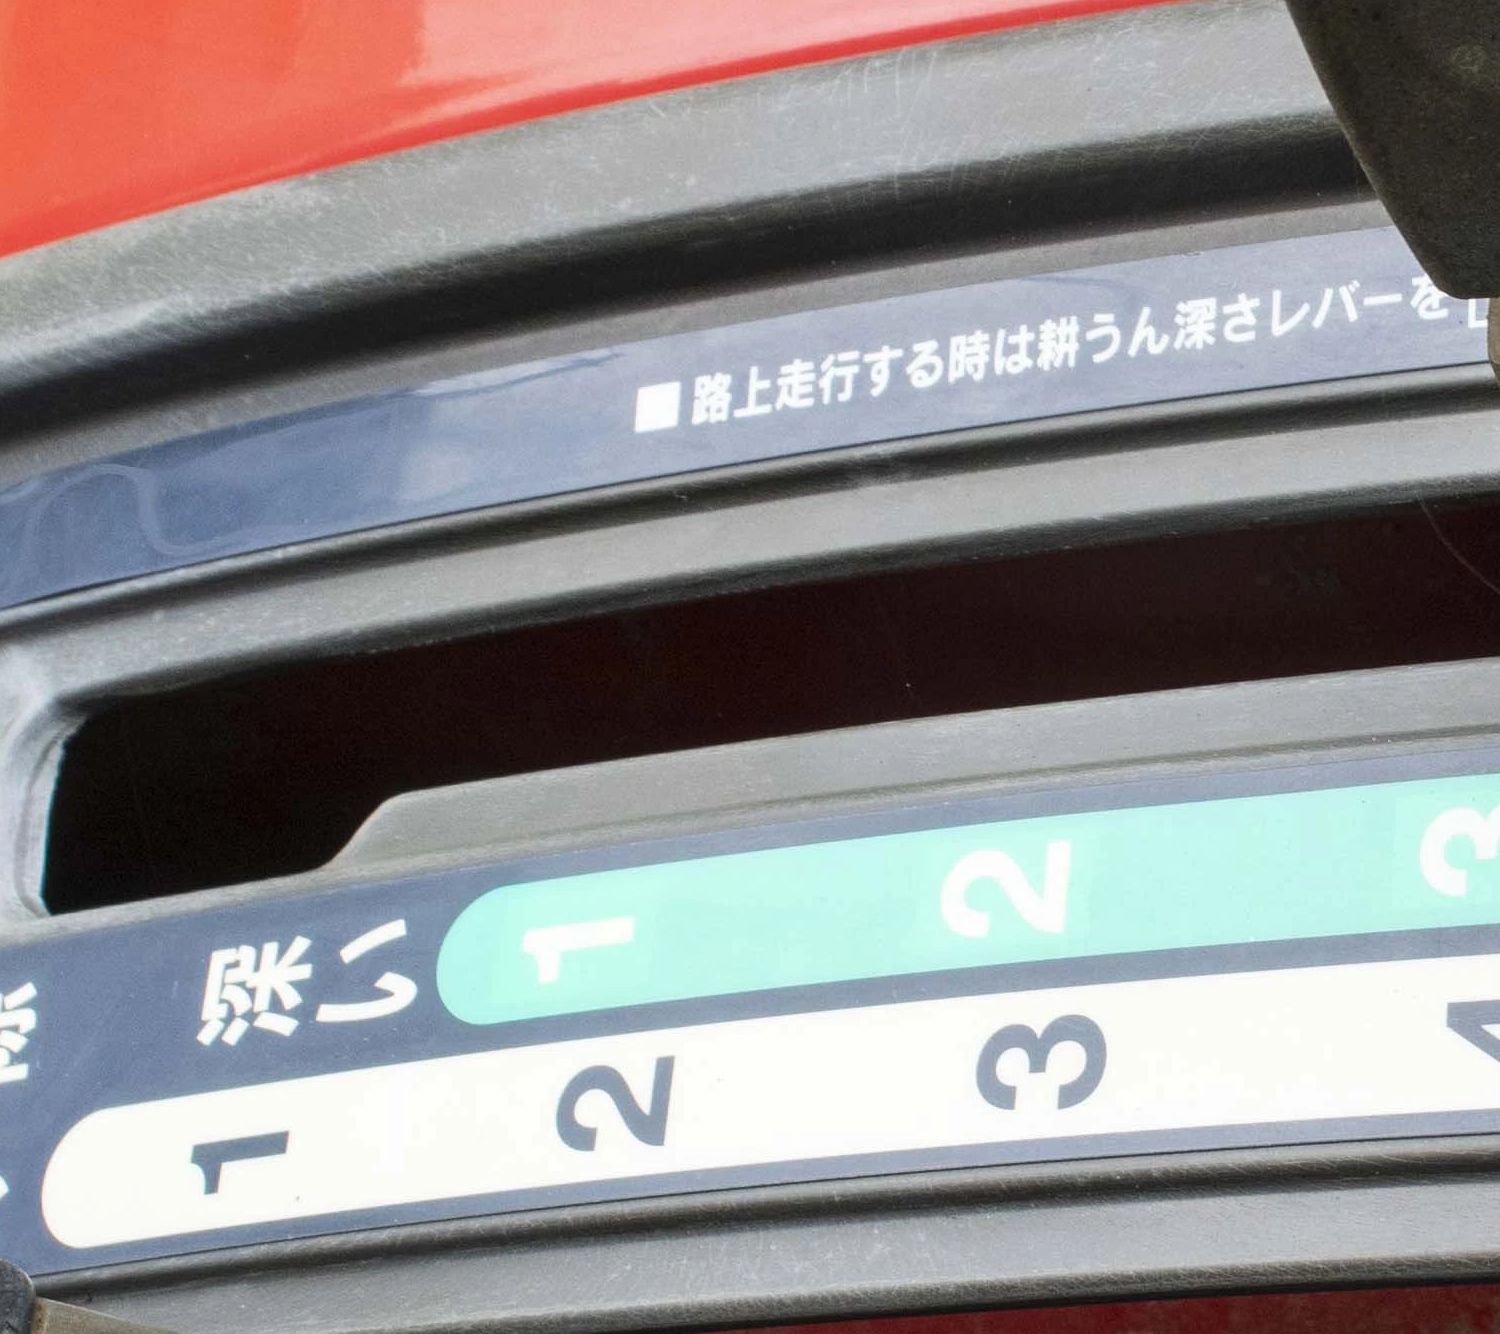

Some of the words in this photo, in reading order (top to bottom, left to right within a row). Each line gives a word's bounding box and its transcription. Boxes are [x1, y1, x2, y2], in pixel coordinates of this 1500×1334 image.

[690, 273, 1488, 426] 路上走行する時は耕うん深さレバーを
[197, 919, 417, 1046] 深い
[522, 916, 635, 984] 1
[940, 839, 1072, 938] 2
[190, 1130, 290, 1195] 1
[555, 1055, 676, 1153] 2
[975, 1013, 1108, 1112] 3
